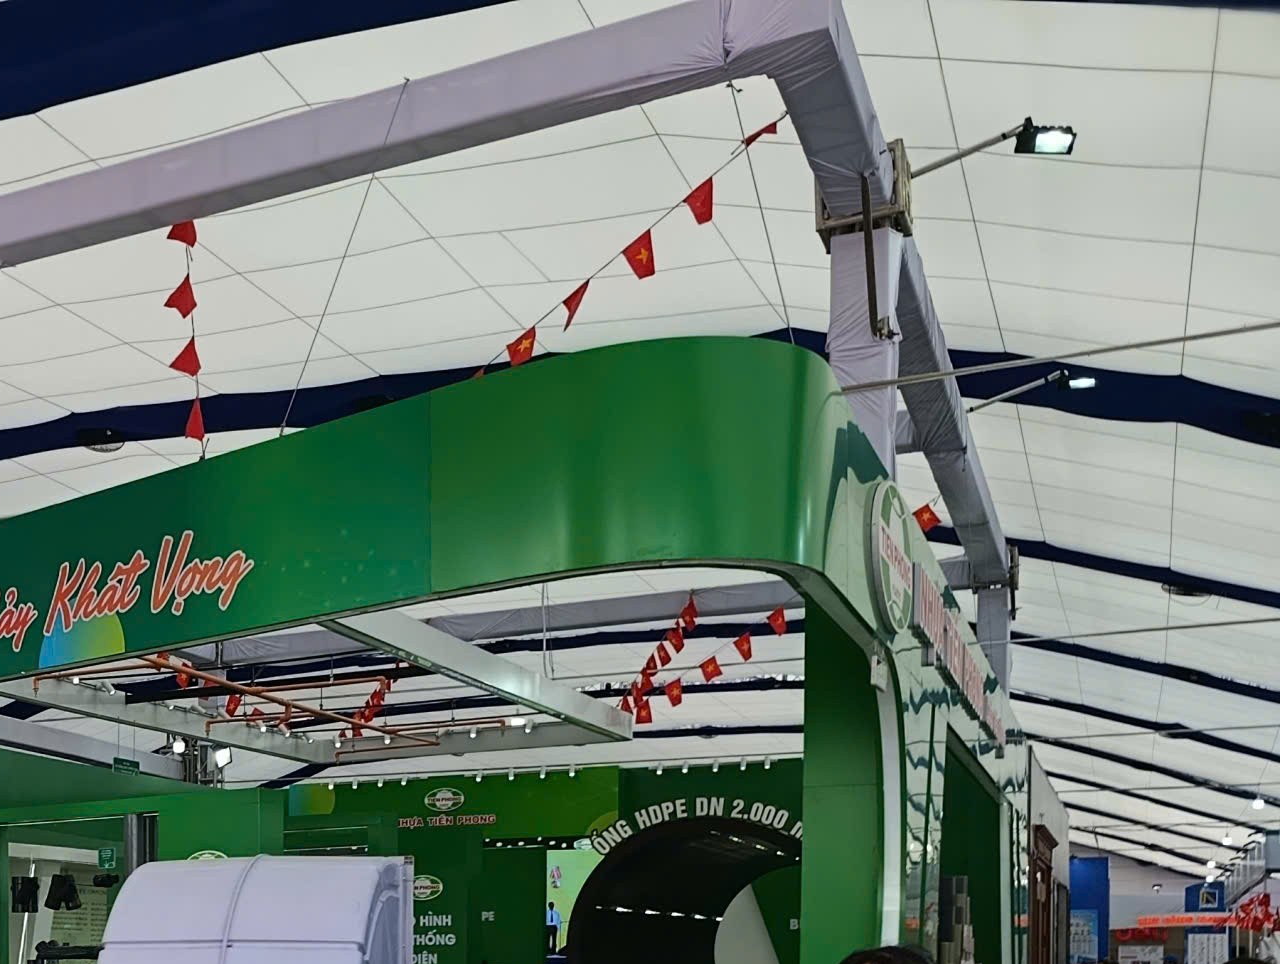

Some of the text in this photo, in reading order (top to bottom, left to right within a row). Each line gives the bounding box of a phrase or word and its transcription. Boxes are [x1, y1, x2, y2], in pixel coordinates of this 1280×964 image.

[152, 530, 255, 616] Vọng
[457, 814, 496, 825] PHONG
[591, 819, 633, 855] ỐNG
[635, 798, 688, 830] HDPE
[695, 797, 724, 817] DN
[731, 798, 789, 829] 2.000
[420, 910, 452, 927] HÌNH
[481, 911, 495, 921] PE
